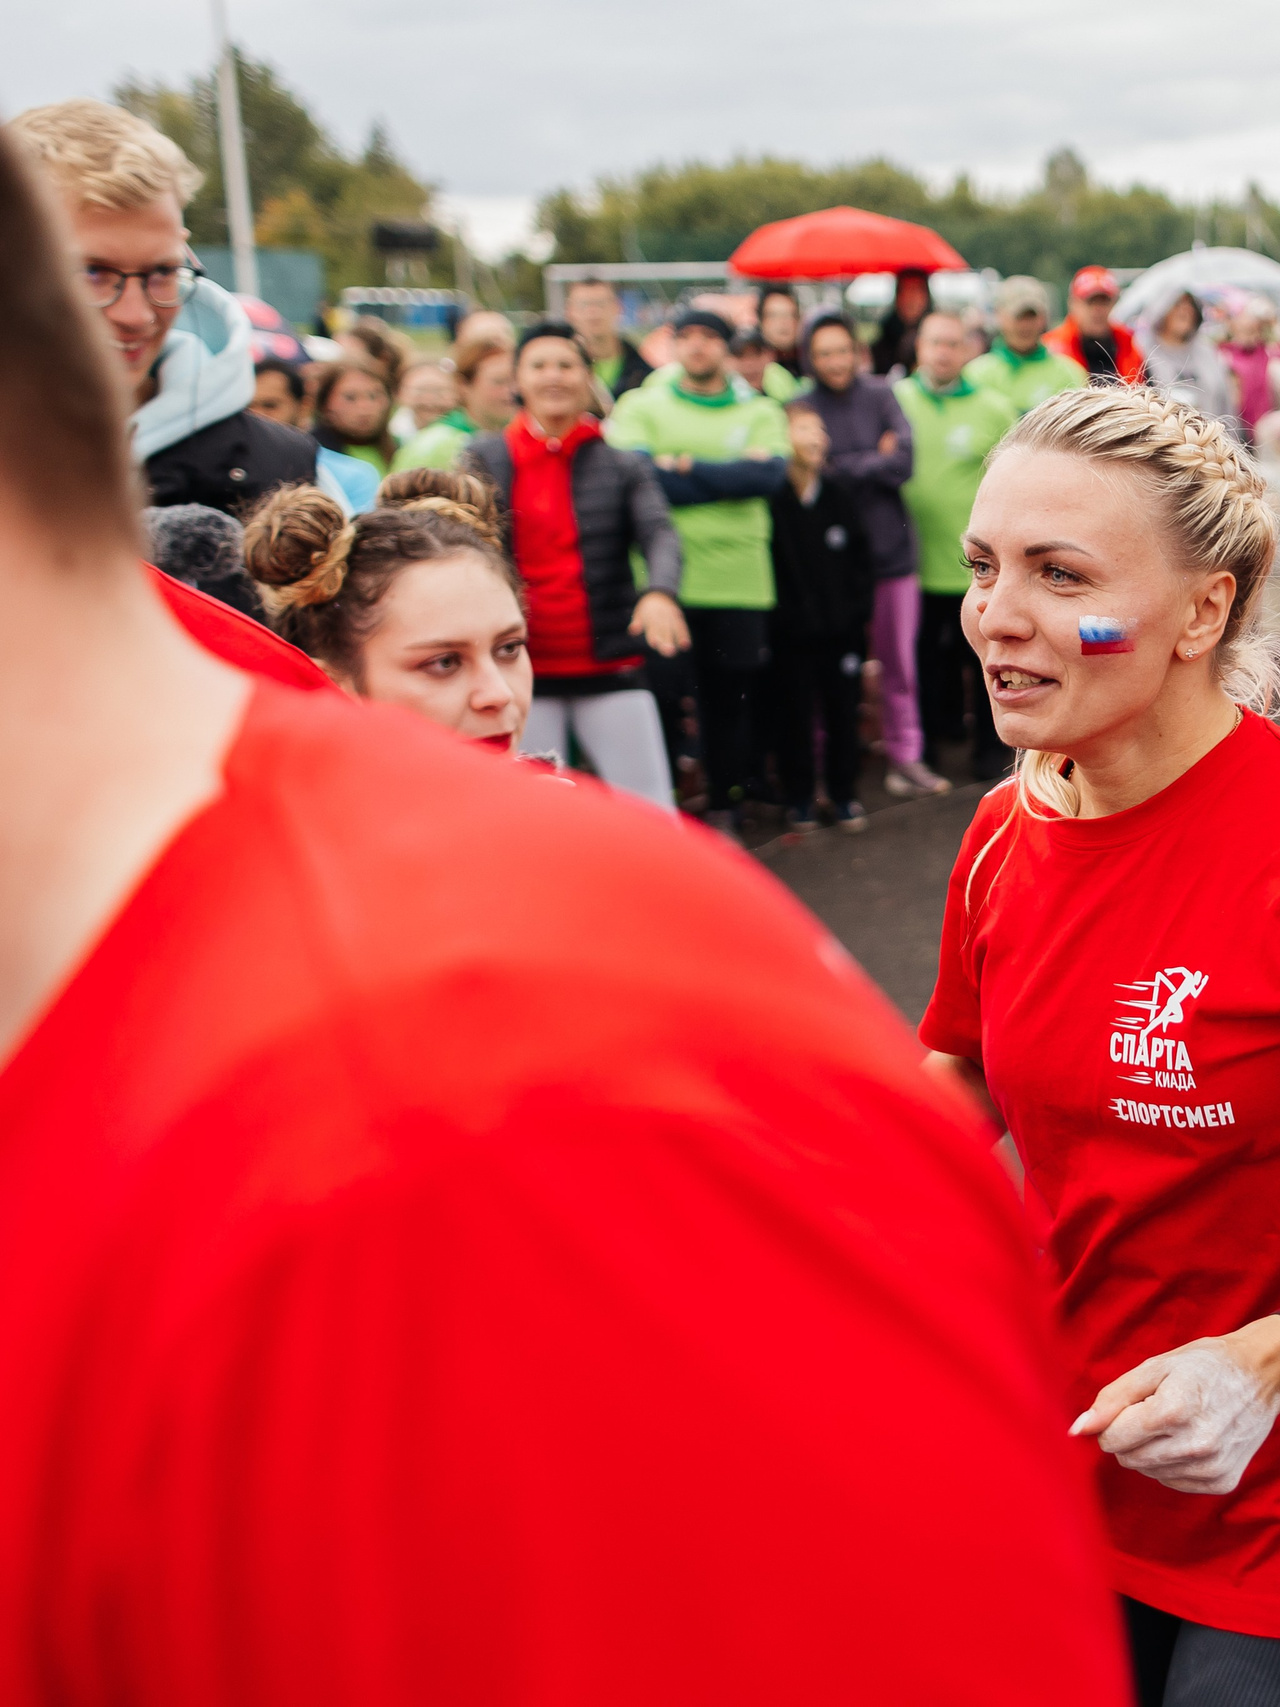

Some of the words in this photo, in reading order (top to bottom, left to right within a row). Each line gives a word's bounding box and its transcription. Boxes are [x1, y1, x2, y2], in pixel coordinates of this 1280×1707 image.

[1109, 1030, 1194, 1071] СПАРТА
[1154, 1070, 1197, 1091] КИАДА
[1112, 1098, 1236, 1128] СПОРТСМЕН
